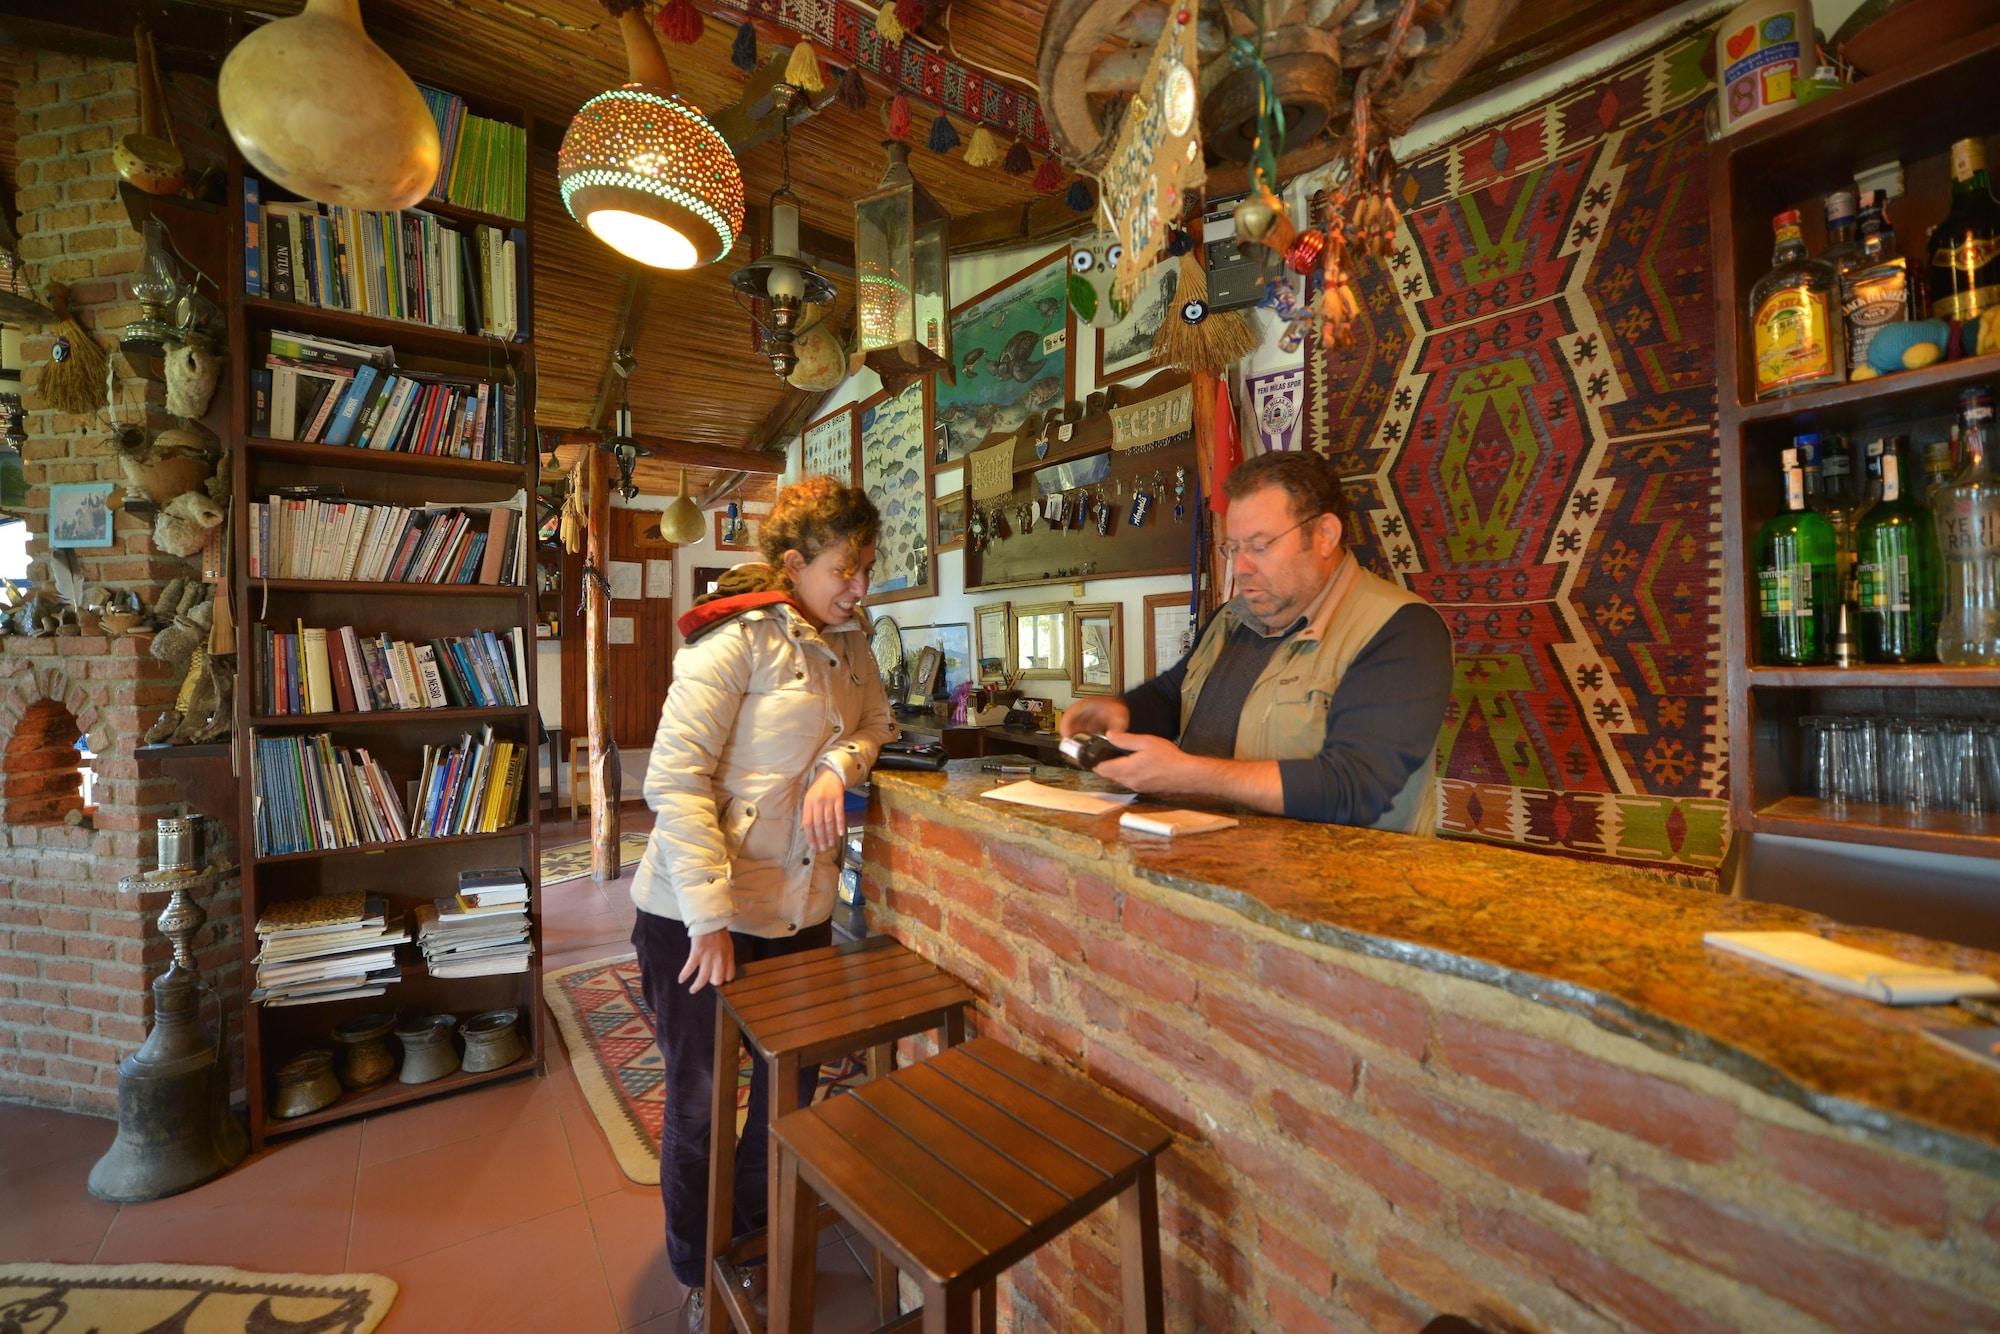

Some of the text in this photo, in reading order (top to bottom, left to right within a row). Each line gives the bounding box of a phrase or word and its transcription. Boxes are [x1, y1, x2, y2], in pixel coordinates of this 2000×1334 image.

[277, 244, 289, 277] NUTUK
[832, 413, 846, 426] BIRDS
[1115, 391, 1192, 442] RECEPTION
